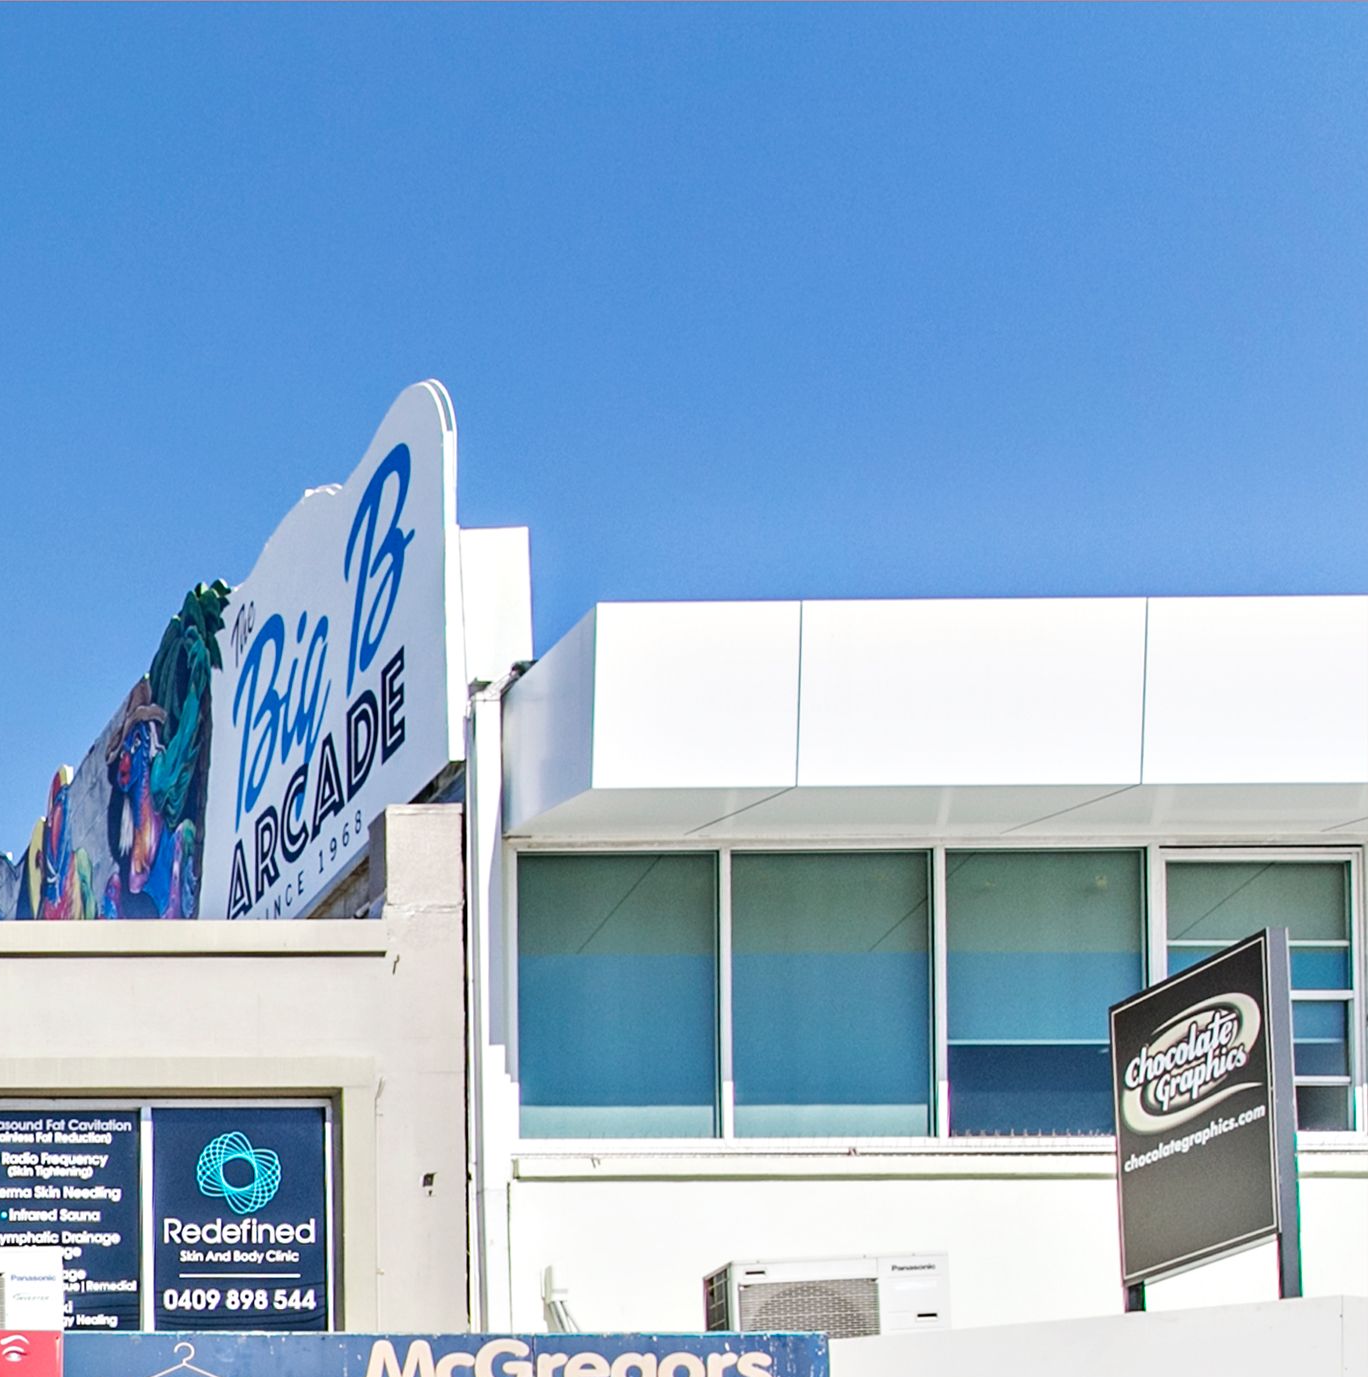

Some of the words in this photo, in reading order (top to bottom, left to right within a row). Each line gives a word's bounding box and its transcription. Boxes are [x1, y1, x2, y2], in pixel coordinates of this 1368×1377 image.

[232, 611, 331, 832] Big
[344, 442, 415, 700] B
[227, 646, 406, 919] ARCADE
[257, 870, 304, 919] INCE
[318, 809, 362, 875] 1968
[1124, 1008, 1239, 1091] Chocolate
[46, 1118, 65, 1131] Fat
[68, 1119, 132, 1132] Cavitation
[36, 1132, 53, 1144] Fat
[54, 1132, 112, 1144] Reduction)
[1124, 1104, 1266, 1174] chocolategraphics.com
[1, 1152, 39, 1165] Radio
[41, 1152, 109, 1167] Frequency
[34, 1185, 61, 1199] Skin
[63, 1186, 122, 1202] Needling
[8, 1208, 58, 1222] Infrared
[59, 1208, 101, 1222] Sauna
[163, 1217, 316, 1244] Redefined
[62, 1231, 121, 1247] Drainage
[180, 1250, 204, 1263] Skin
[206, 1250, 231, 1263] And
[234, 1250, 263, 1264] Body
[265, 1250, 299, 1263] Clinic
[891, 1262, 936, 1272] Panasonic
[10, 1274, 57, 1282] Panasonic
[86, 1280, 137, 1292] Remedial
[164, 1290, 220, 1311] 0409
[226, 1290, 268, 1310] 898
[274, 1289, 317, 1310] 544
[76, 1315, 118, 1328] Healing
